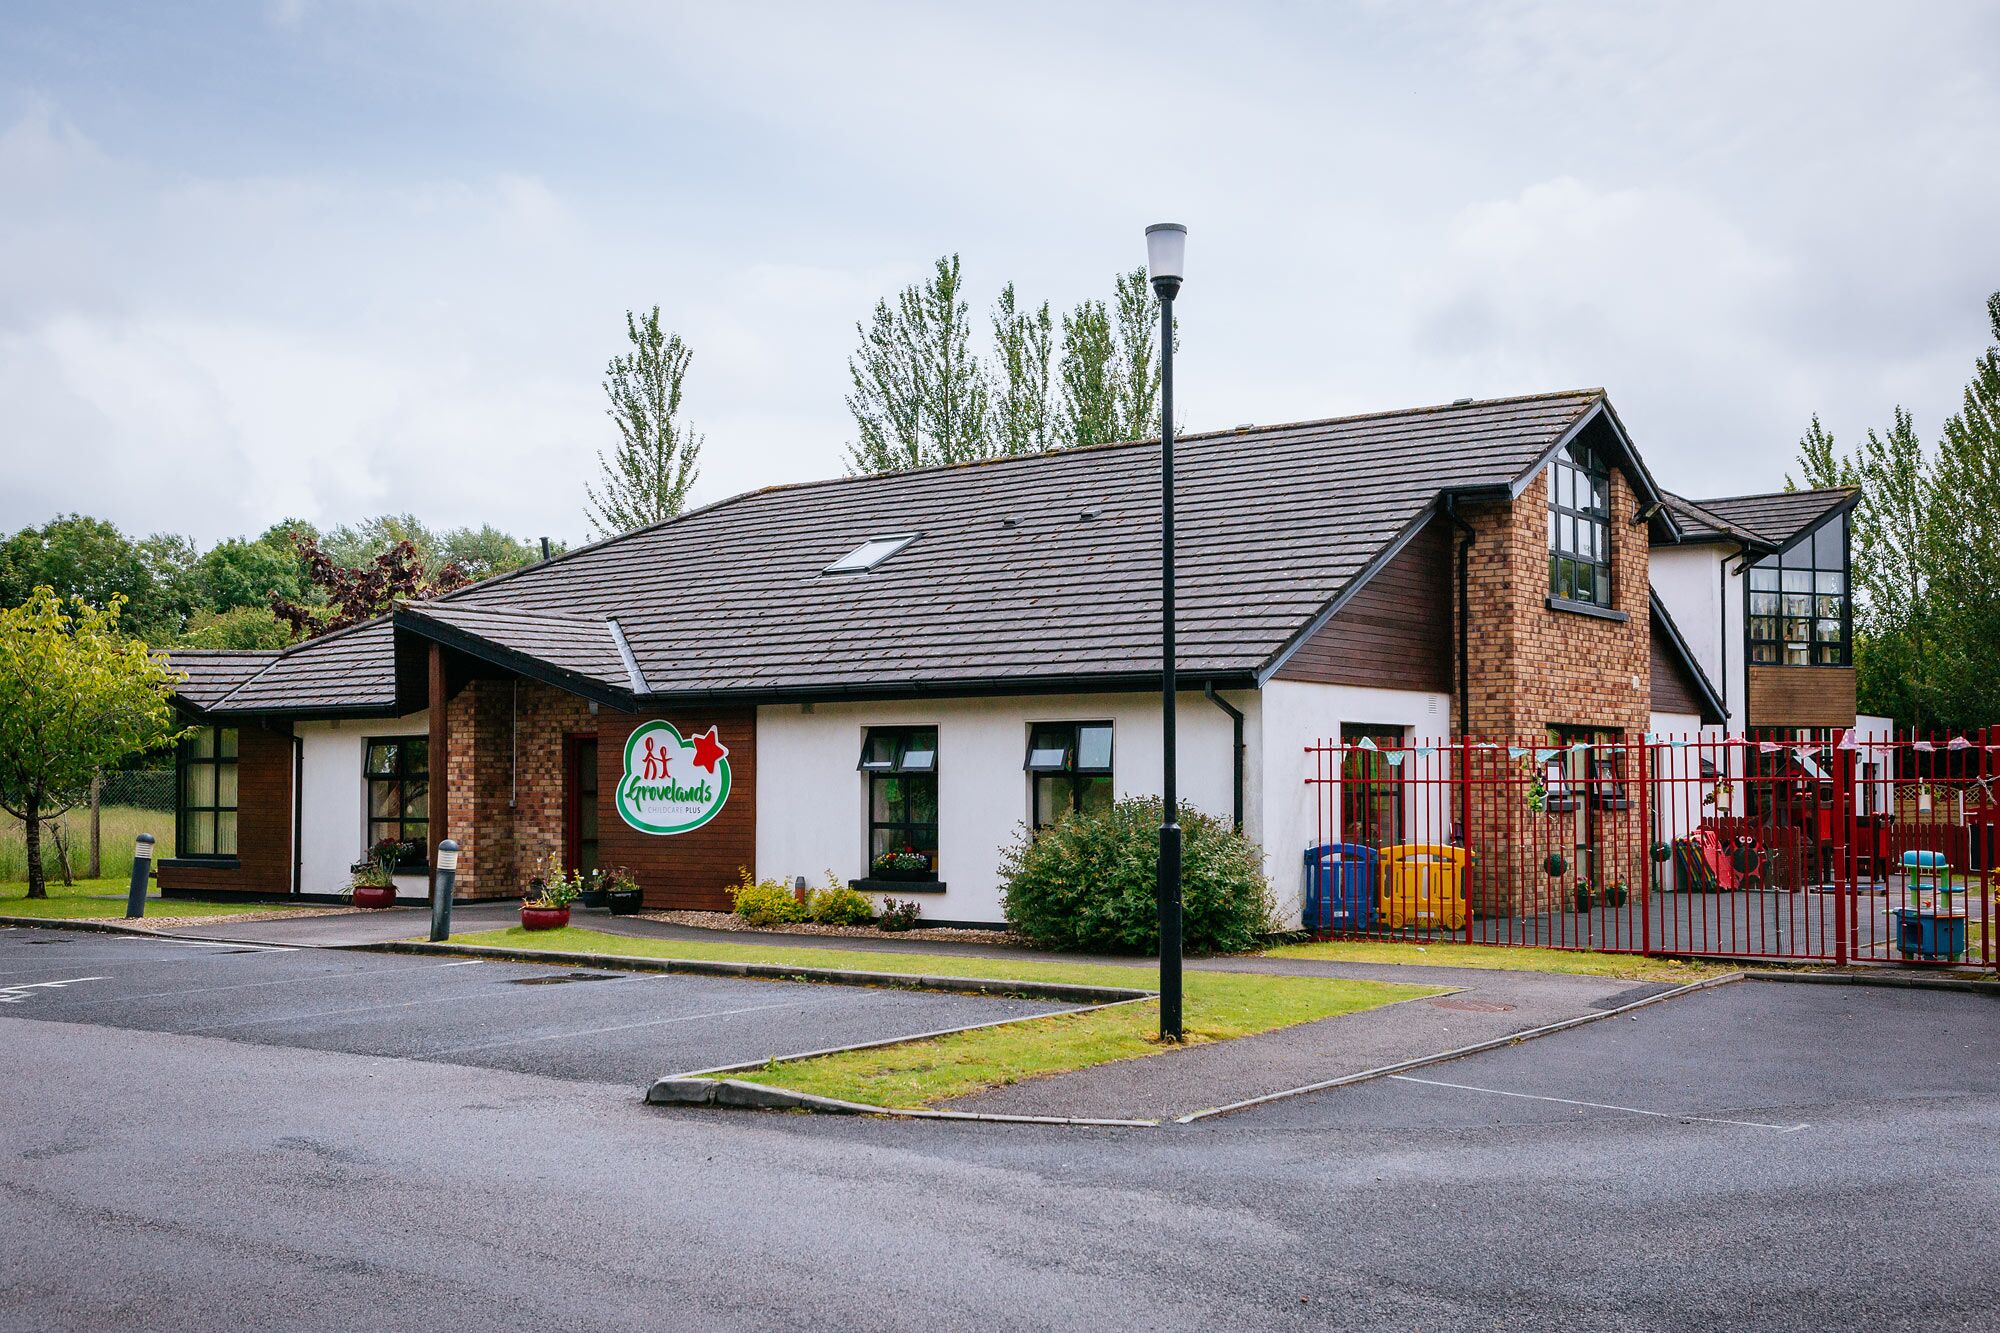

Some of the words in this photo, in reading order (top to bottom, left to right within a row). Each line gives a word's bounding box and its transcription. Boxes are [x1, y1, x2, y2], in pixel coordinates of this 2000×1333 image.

[625, 775, 712, 812] Grovelands
[647, 806, 683, 814] CHILDCARE
[685, 806, 701, 814] PLUS
